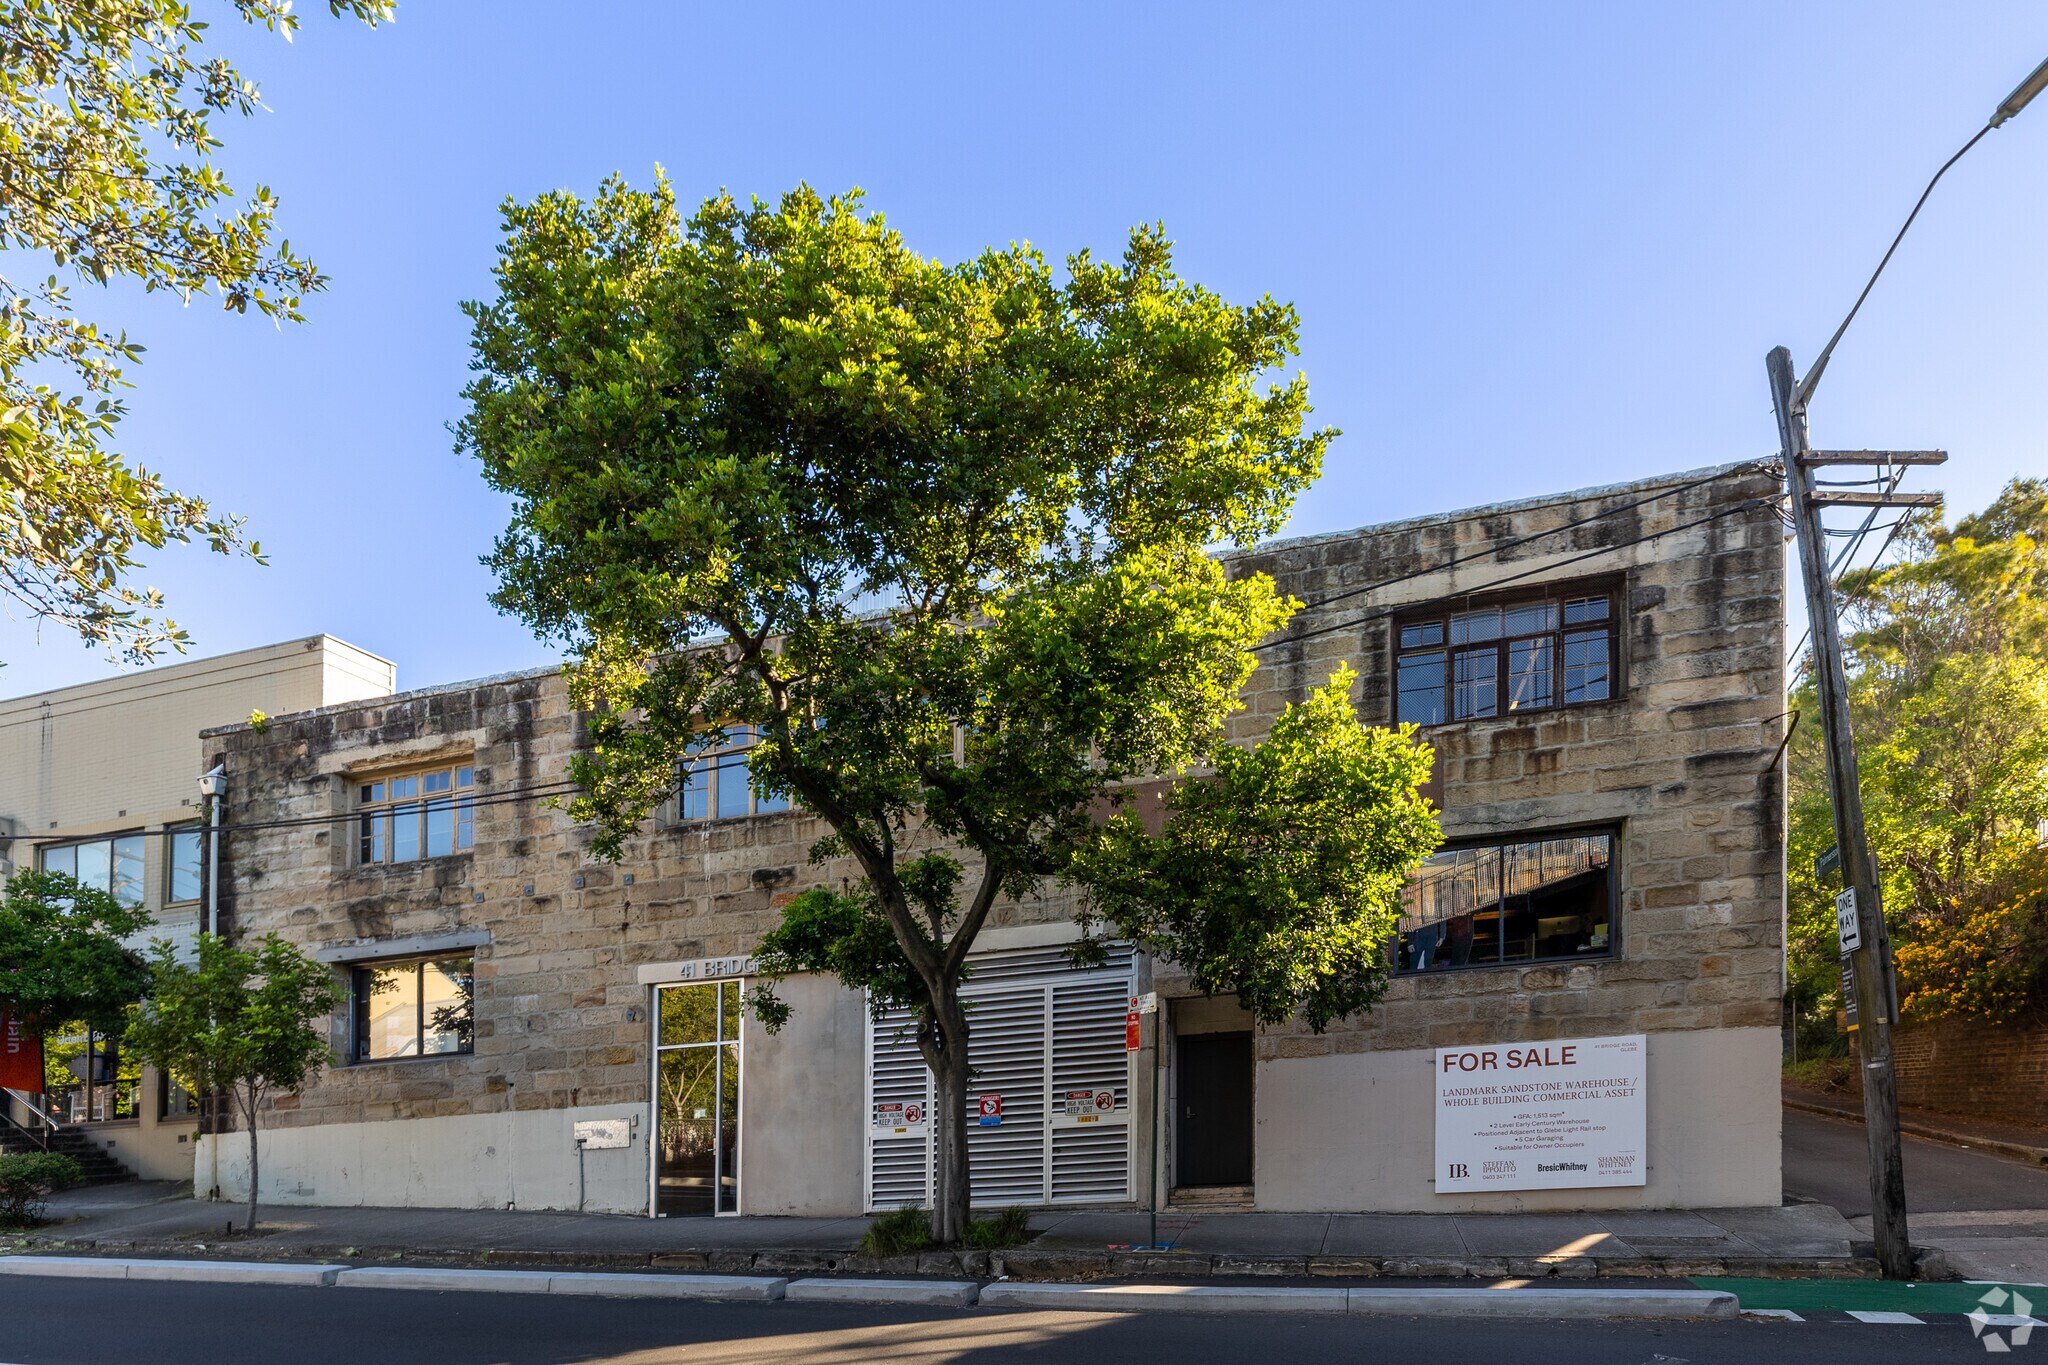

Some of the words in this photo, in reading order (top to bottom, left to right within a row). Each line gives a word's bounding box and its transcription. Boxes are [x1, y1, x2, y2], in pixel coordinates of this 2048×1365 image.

[1839, 894, 1852, 911] ONE
[1839, 912, 1854, 931] WAY
[680, 962, 696, 978] 41
[1443, 1051, 1498, 1073] FOR
[1506, 1046, 1577, 1069] SALE
[1442, 1086, 1498, 1097] LANDMARK
[1501, 1082, 1562, 1094] SANDSTONE
[1565, 1078, 1629, 1089] WAREHOUSE
[1444, 1098, 1479, 1107] WHOLE
[1482, 1095, 1530, 1105] BUILDING
[1533, 1091, 1601, 1102] COMMERCIAL
[1604, 1088, 1636, 1098] ASSET
[1067, 1106, 1080, 1114] KEEP
[1083, 1105, 1094, 1114] OUT
[878, 1118, 891, 1126] KEEP
[893, 1118, 903, 1126] OUT
[1554, 1141, 1585, 1149] Occupiers
[1598, 1155, 1635, 1163] SHANNAN
[1448, 1163, 1470, 1178] IB.
[1537, 1162, 1588, 1172] BresicWhitney
